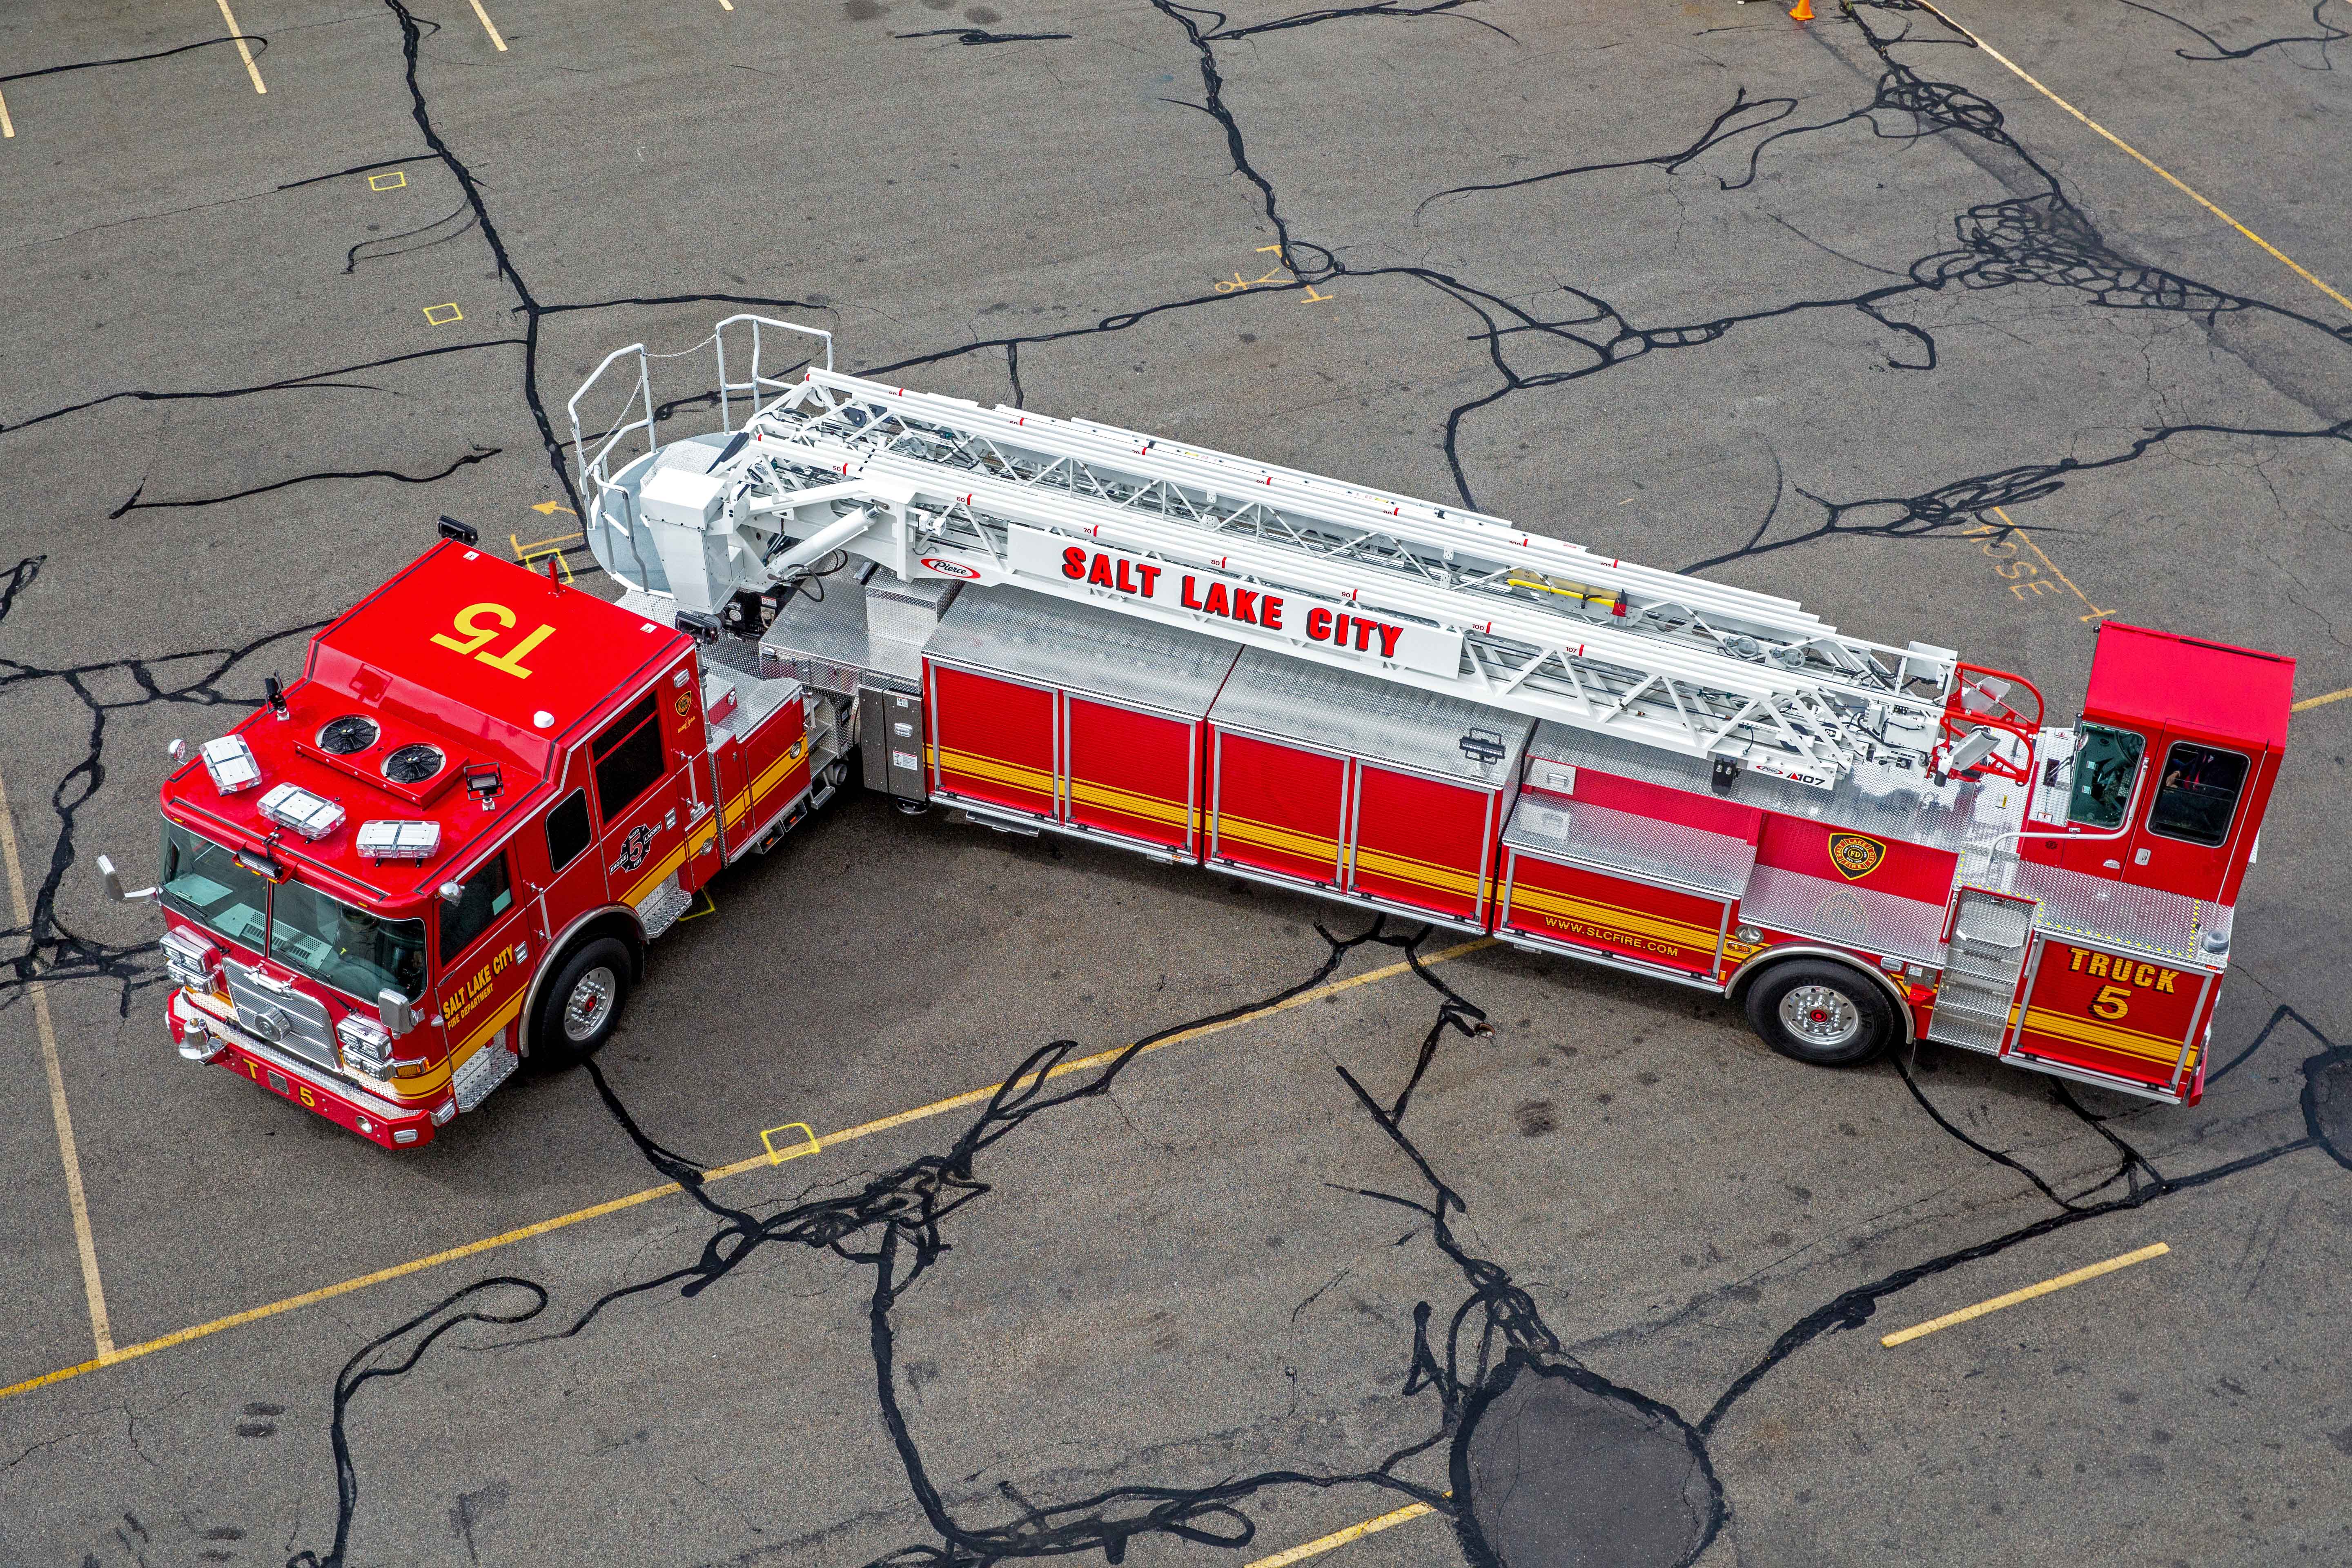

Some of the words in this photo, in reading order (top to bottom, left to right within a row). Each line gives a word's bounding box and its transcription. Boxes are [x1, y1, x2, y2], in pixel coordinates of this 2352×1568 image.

[933, 561, 967, 575] Pierce
[1062, 546, 1161, 598] SALT
[1180, 575, 1283, 630] LAKE
[1306, 607, 1404, 658] CITY
[430, 603, 557, 679] T5
[628, 829, 639, 840] SLCFD
[629, 832, 643, 862] 5
[645, 824, 661, 841] LADDER
[610, 855, 627, 872] ENGINE
[634, 857, 642, 867] HRT
[1545, 917, 1678, 957] WWW.SLCFIRE.COM
[443, 987, 465, 1020] SALT
[467, 964, 492, 999] LAKE
[493, 943, 513, 975] CITY
[2069, 947, 2180, 994] TRUCK
[447, 1015, 460, 1031] FIRE
[461, 983, 494, 1020] DEPARTMENT
[2089, 984, 2132, 1020] 5
[242, 1058, 258, 1079] T
[299, 1086, 315, 1107] 5
